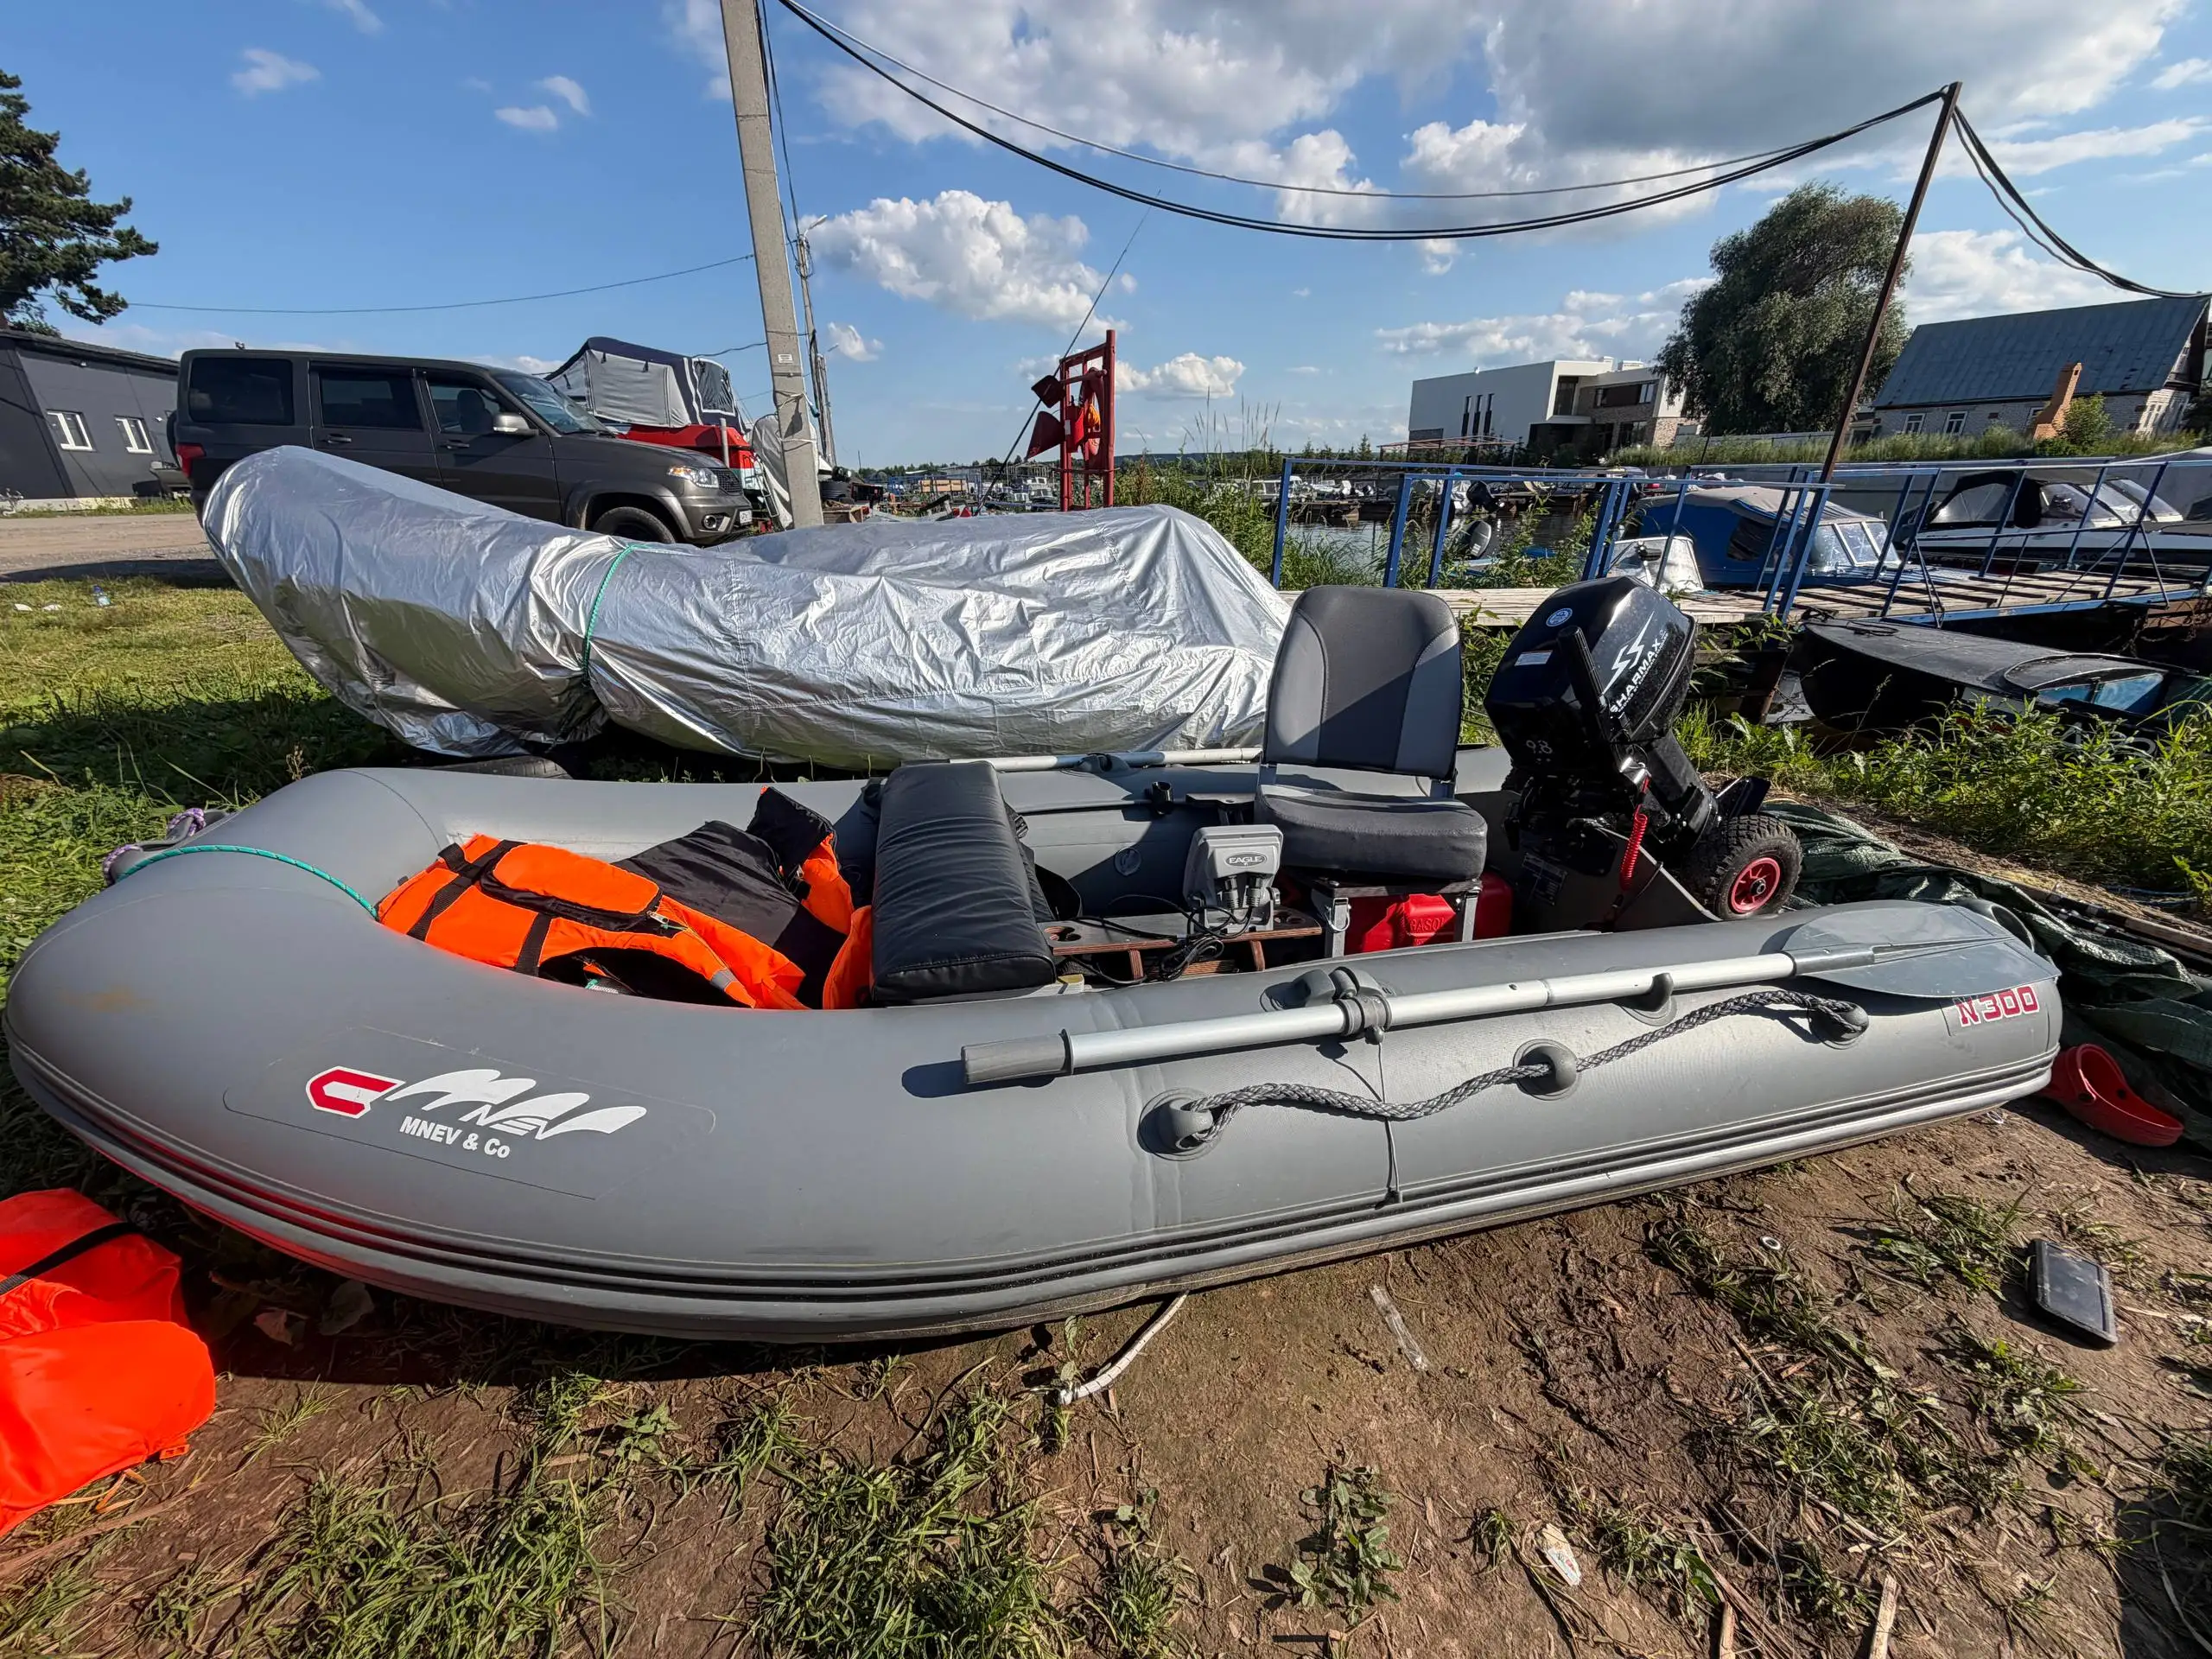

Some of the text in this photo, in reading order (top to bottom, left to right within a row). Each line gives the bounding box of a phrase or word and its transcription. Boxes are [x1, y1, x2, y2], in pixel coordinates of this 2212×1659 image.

[1610, 639, 1661, 713] SHARMAX
[1229, 855, 1262, 864] EAGLE
[399, 1116, 511, 1159] MNEV & Co
